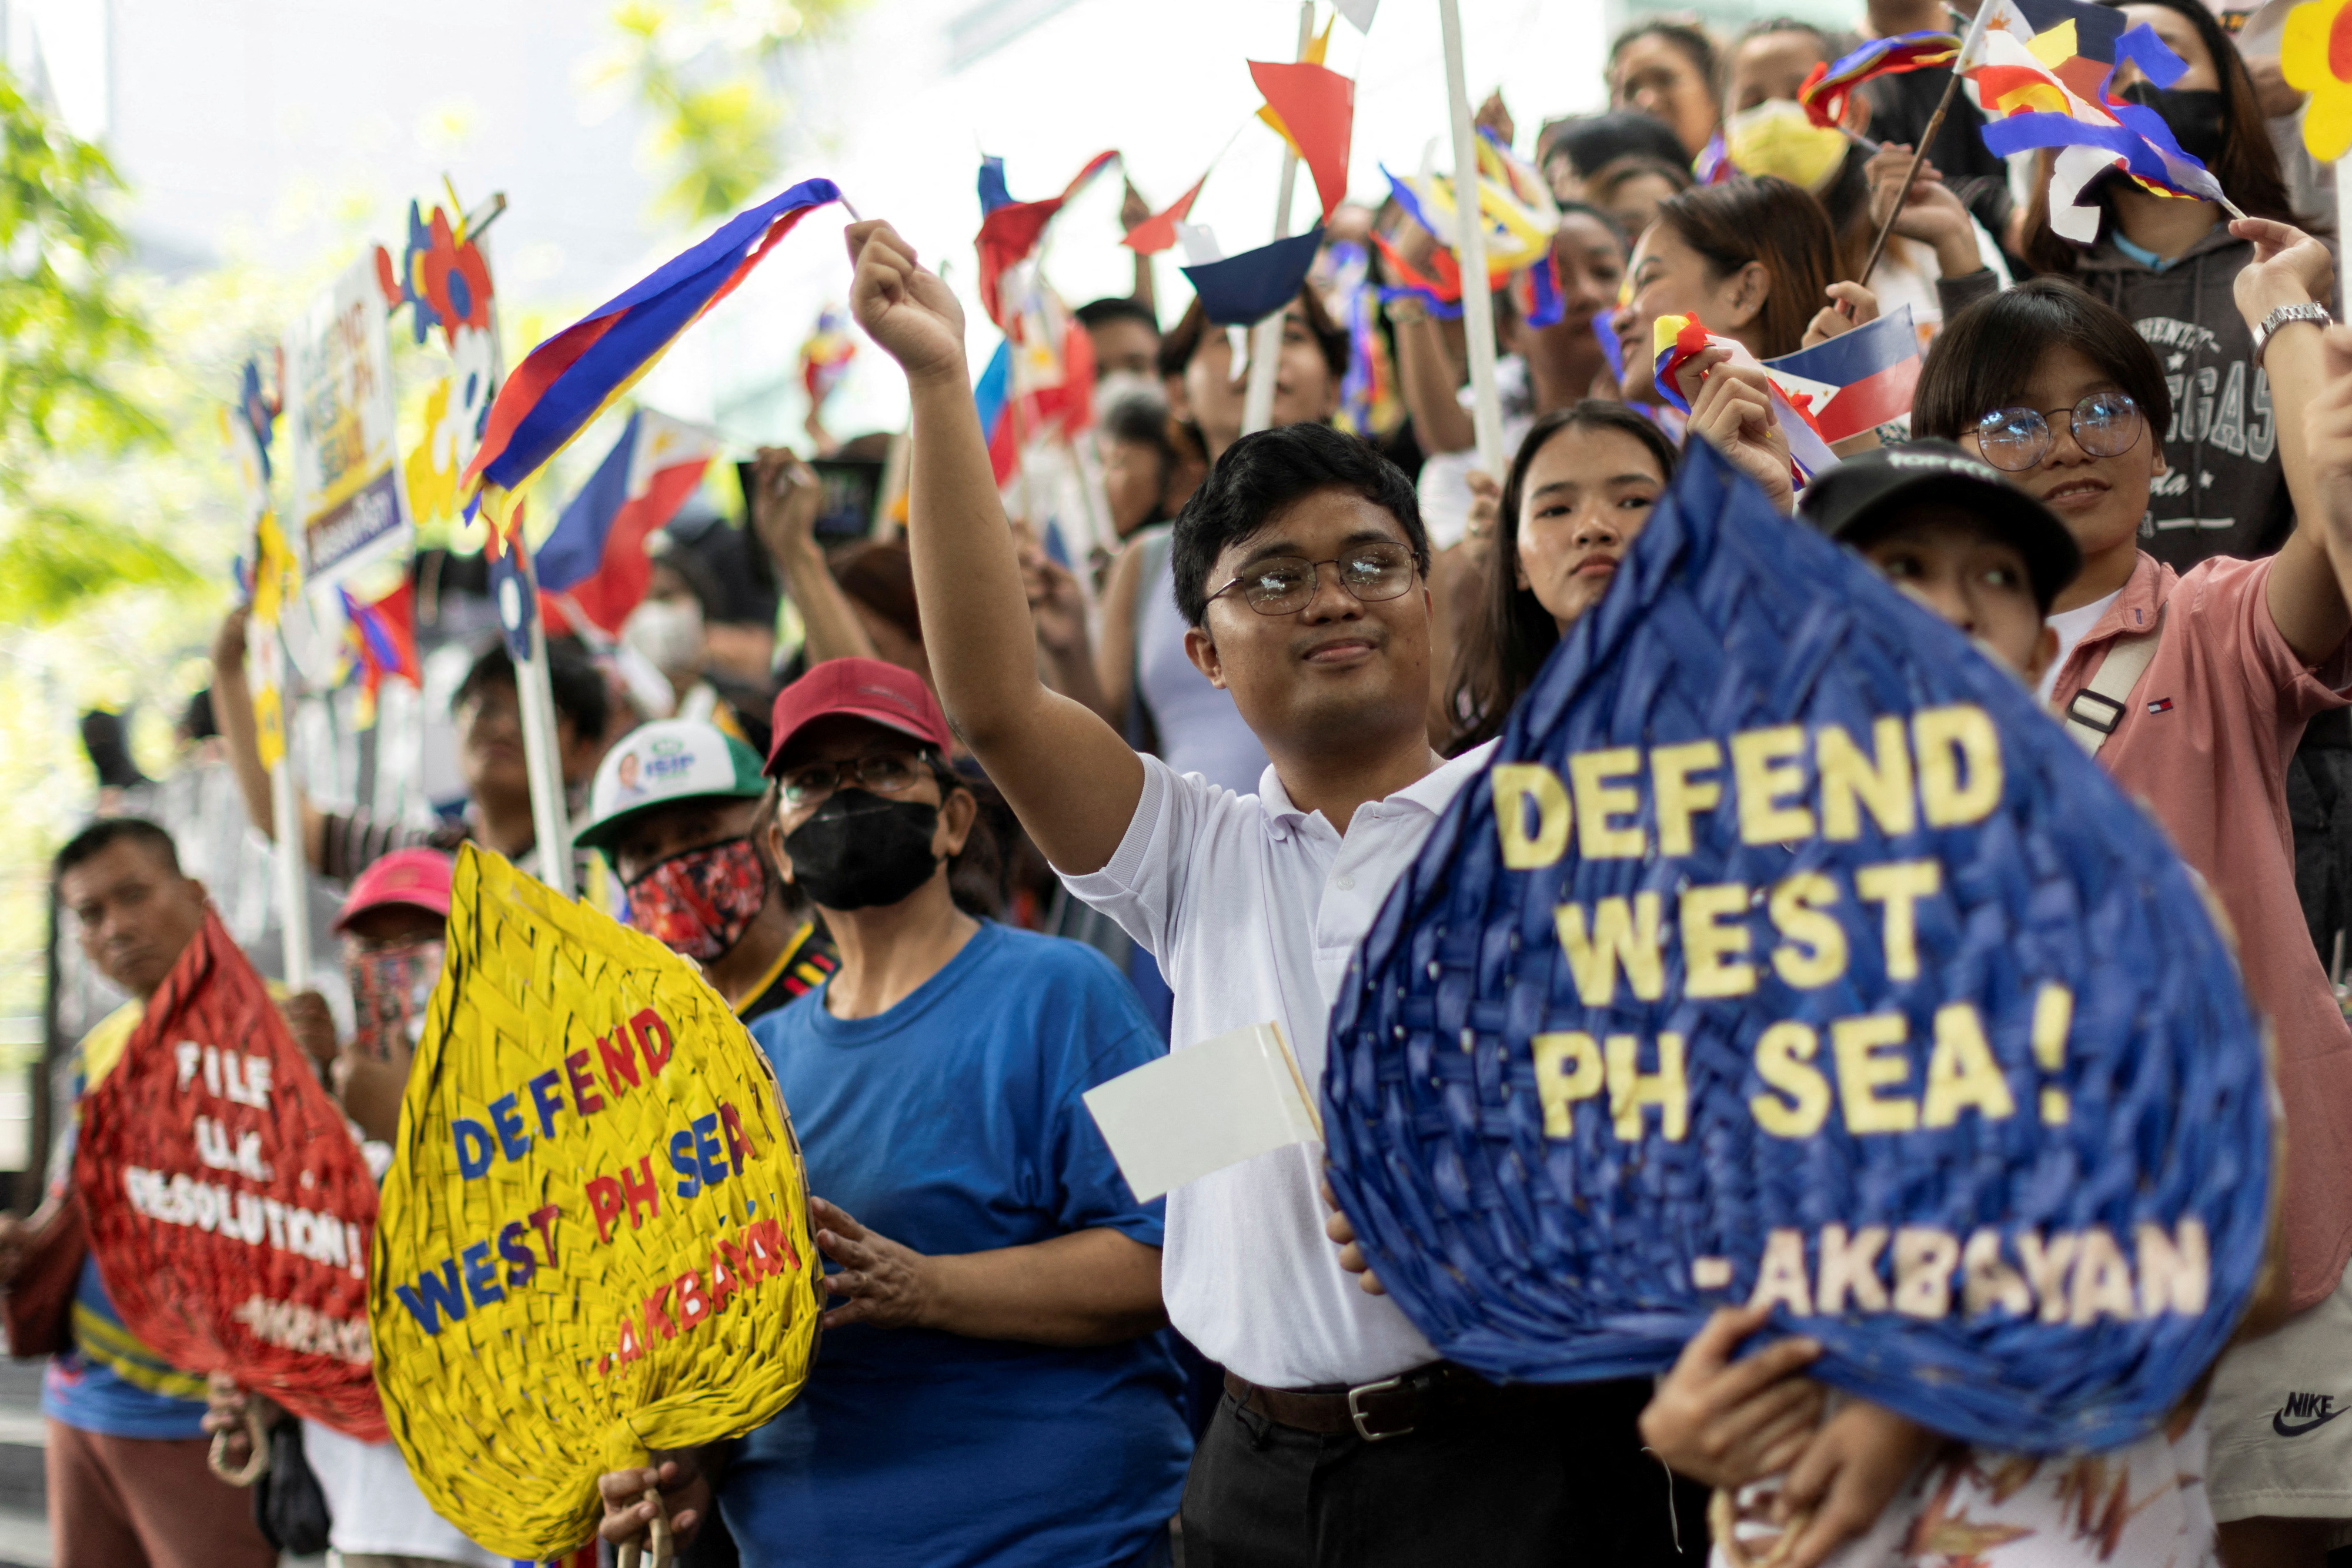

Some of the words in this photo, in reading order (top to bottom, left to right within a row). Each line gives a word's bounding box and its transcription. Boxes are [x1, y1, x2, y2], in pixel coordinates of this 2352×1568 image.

[1491, 706, 2003, 870] DEFEND
[1553, 859, 1942, 1007] WEST
[176, 1041, 273, 1110] FILE
[450, 1007, 671, 1181] DEFEND
[1532, 1031, 1687, 1142] PH
[1750, 983, 2076, 1137] SEA!
[124, 1165, 366, 1280] RESOLUTION!
[394, 1204, 559, 1336] WEST
[585, 1155, 660, 1244] PH
[670, 1101, 755, 1198] SEA
[2283, 1392, 2334, 1418] NIKE
